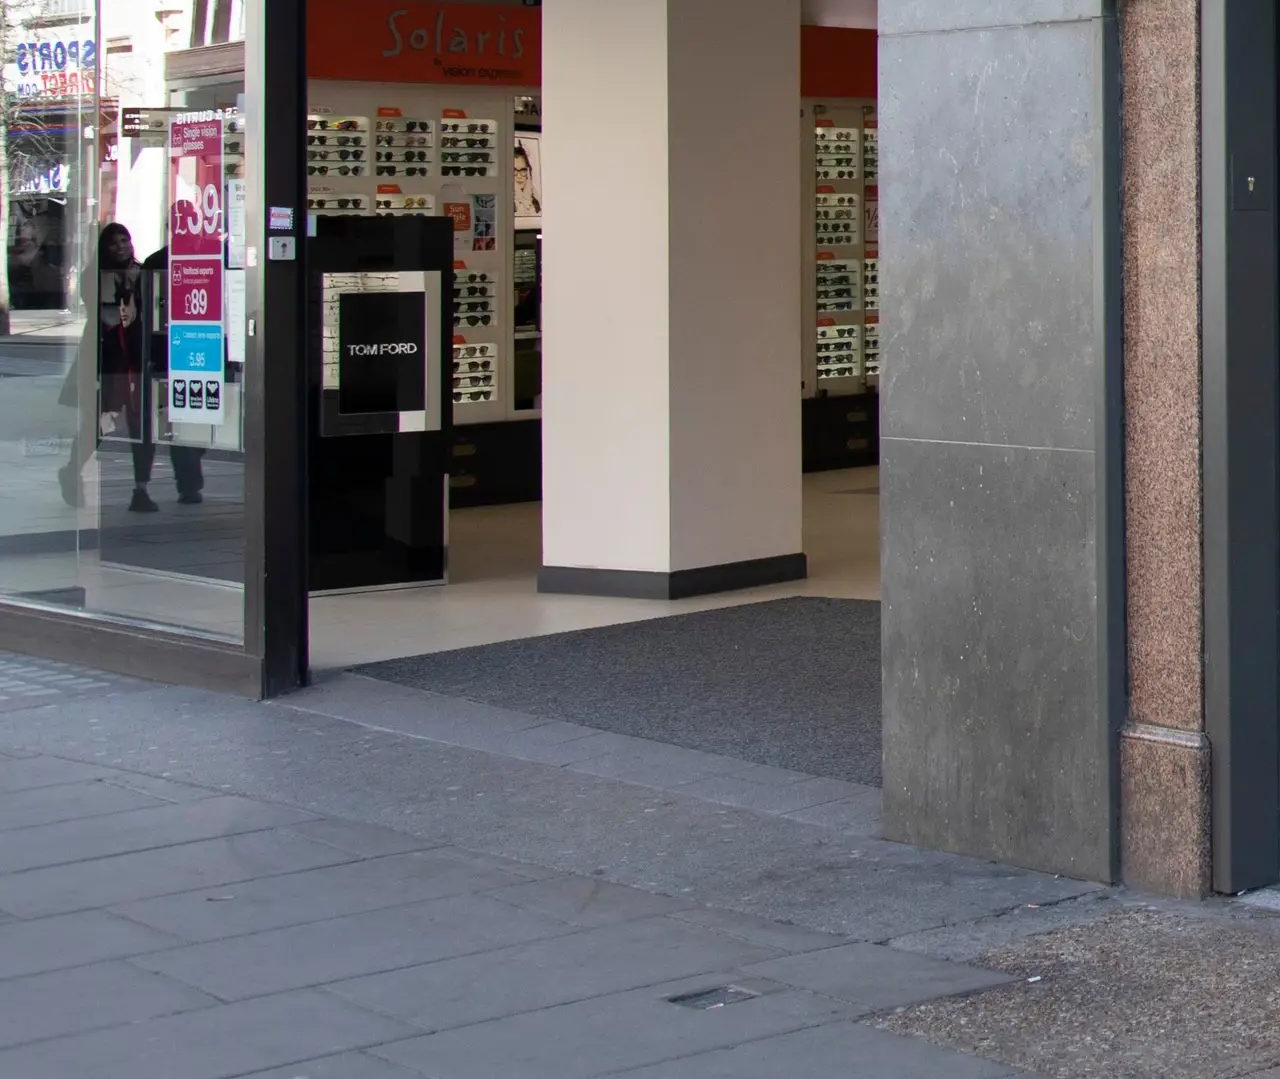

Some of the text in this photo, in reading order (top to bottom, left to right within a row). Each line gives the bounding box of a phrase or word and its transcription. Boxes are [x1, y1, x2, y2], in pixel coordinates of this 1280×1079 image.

[381, 8, 524, 60] Solaris
[442, 65, 475, 77] vision
[183, 126, 217, 140] Single vision
[183, 140, 204, 153] glasses
[175, 183, 219, 235] £39
[185, 288, 207, 315] £89
[347, 342, 418, 356] TOM FORD
